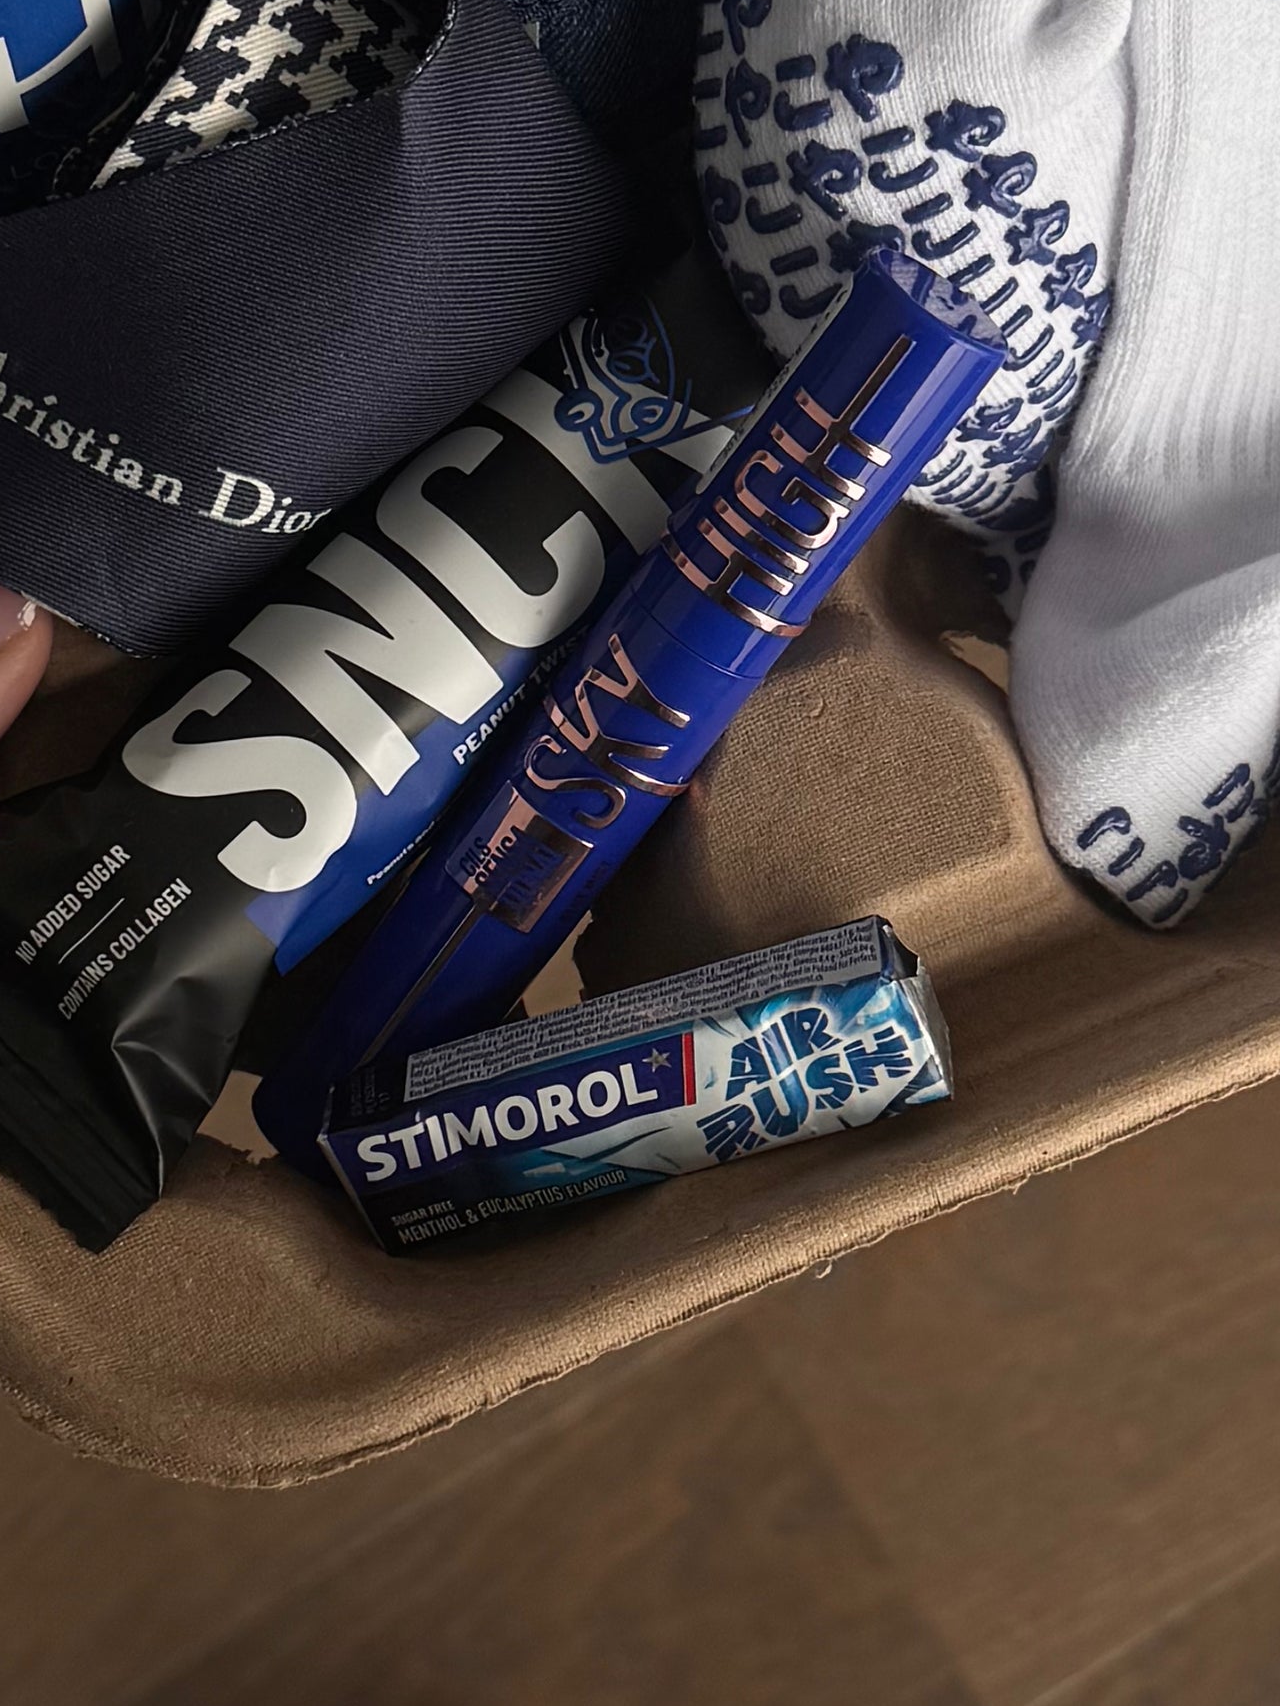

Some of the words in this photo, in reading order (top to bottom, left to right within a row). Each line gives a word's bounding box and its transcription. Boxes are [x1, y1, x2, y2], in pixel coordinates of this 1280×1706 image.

[523, 632, 692, 830] SKY
[660, 332, 918, 639] HIGH
[452, 691, 529, 766] PEANUT
[14, 939, 37, 966] NO
[29, 892, 83, 949] ADDED
[75, 844, 132, 900] SUGAR
[458, 835, 492, 879] CILS
[57, 952, 115, 1021] CONTAINS
[108, 877, 193, 961] COLLAGEN
[695, 1025, 913, 1164] RUSH
[724, 1006, 844, 1102] AIR
[355, 1062, 658, 1184] STIMOROL
[390, 1206, 428, 1228] SUGAR
[396, 1215, 467, 1245] MENTHOL
[465, 1208, 480, 1226] &
[476, 1184, 566, 1220] EUCALYPTUS
[564, 1169, 628, 1199] FLAVOUR
